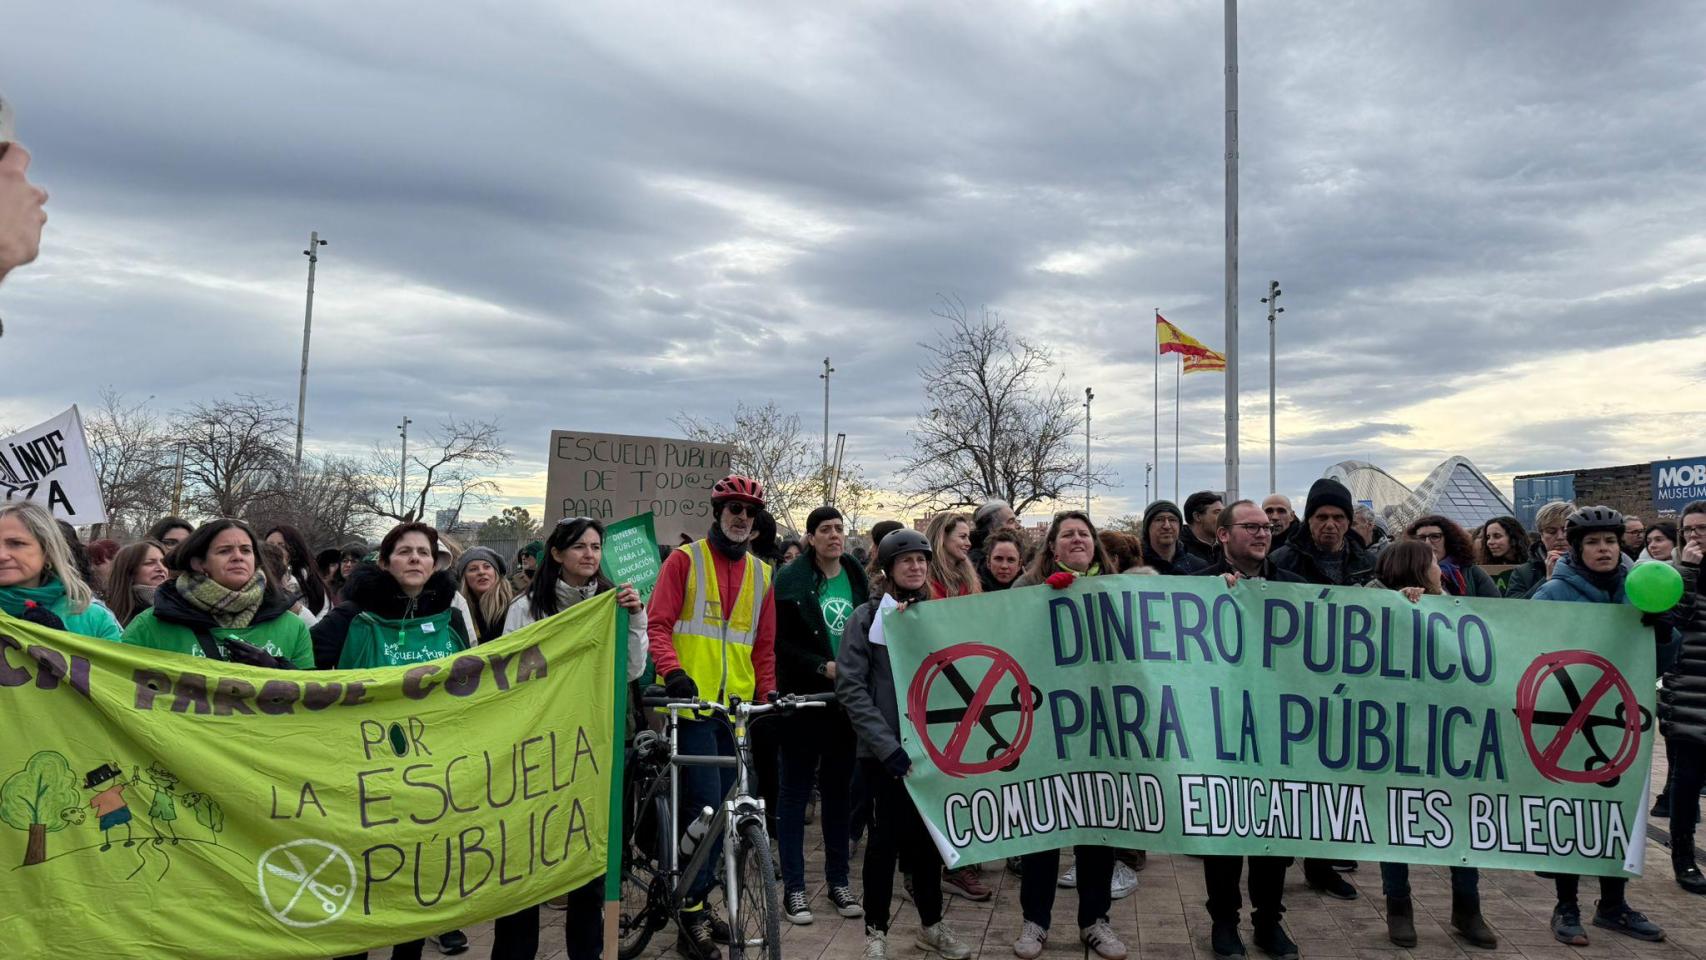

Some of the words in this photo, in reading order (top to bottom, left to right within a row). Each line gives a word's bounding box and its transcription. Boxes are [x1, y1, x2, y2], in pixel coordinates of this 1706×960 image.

[557, 436, 656, 466] ESCUELA
[664, 443, 731, 468] PÚBLICA
[584, 470, 617, 491] DE
[631, 470, 715, 492] TOD@S
[1658, 486, 1706, 500] MUSEUM
[563, 498, 613, 518] PARA
[631, 499, 710, 517] TOD@S
[612, 527, 638, 541] DINERO
[617, 556, 655, 576] EDUCACIÓN
[619, 552, 636, 563] PARA
[637, 548, 646, 556] LA
[1048, 591, 1244, 667] DINERO
[1262, 588, 1494, 683] PÚBLICO
[133, 667, 377, 716] PARQUE
[361, 716, 432, 760] POR
[1048, 684, 1190, 761] PARA
[1210, 686, 1260, 763] LA
[1279, 683, 1505, 780] PÚBLICA
[270, 782, 327, 819] LA
[358, 726, 599, 828] ESCUELA
[944, 771, 1164, 848] COMUNIDAD
[1179, 774, 1376, 845] EDUCATIVA
[1387, 787, 1454, 849] IES
[1468, 791, 1629, 861] BLECUA
[362, 797, 591, 916] PÚBLICA
